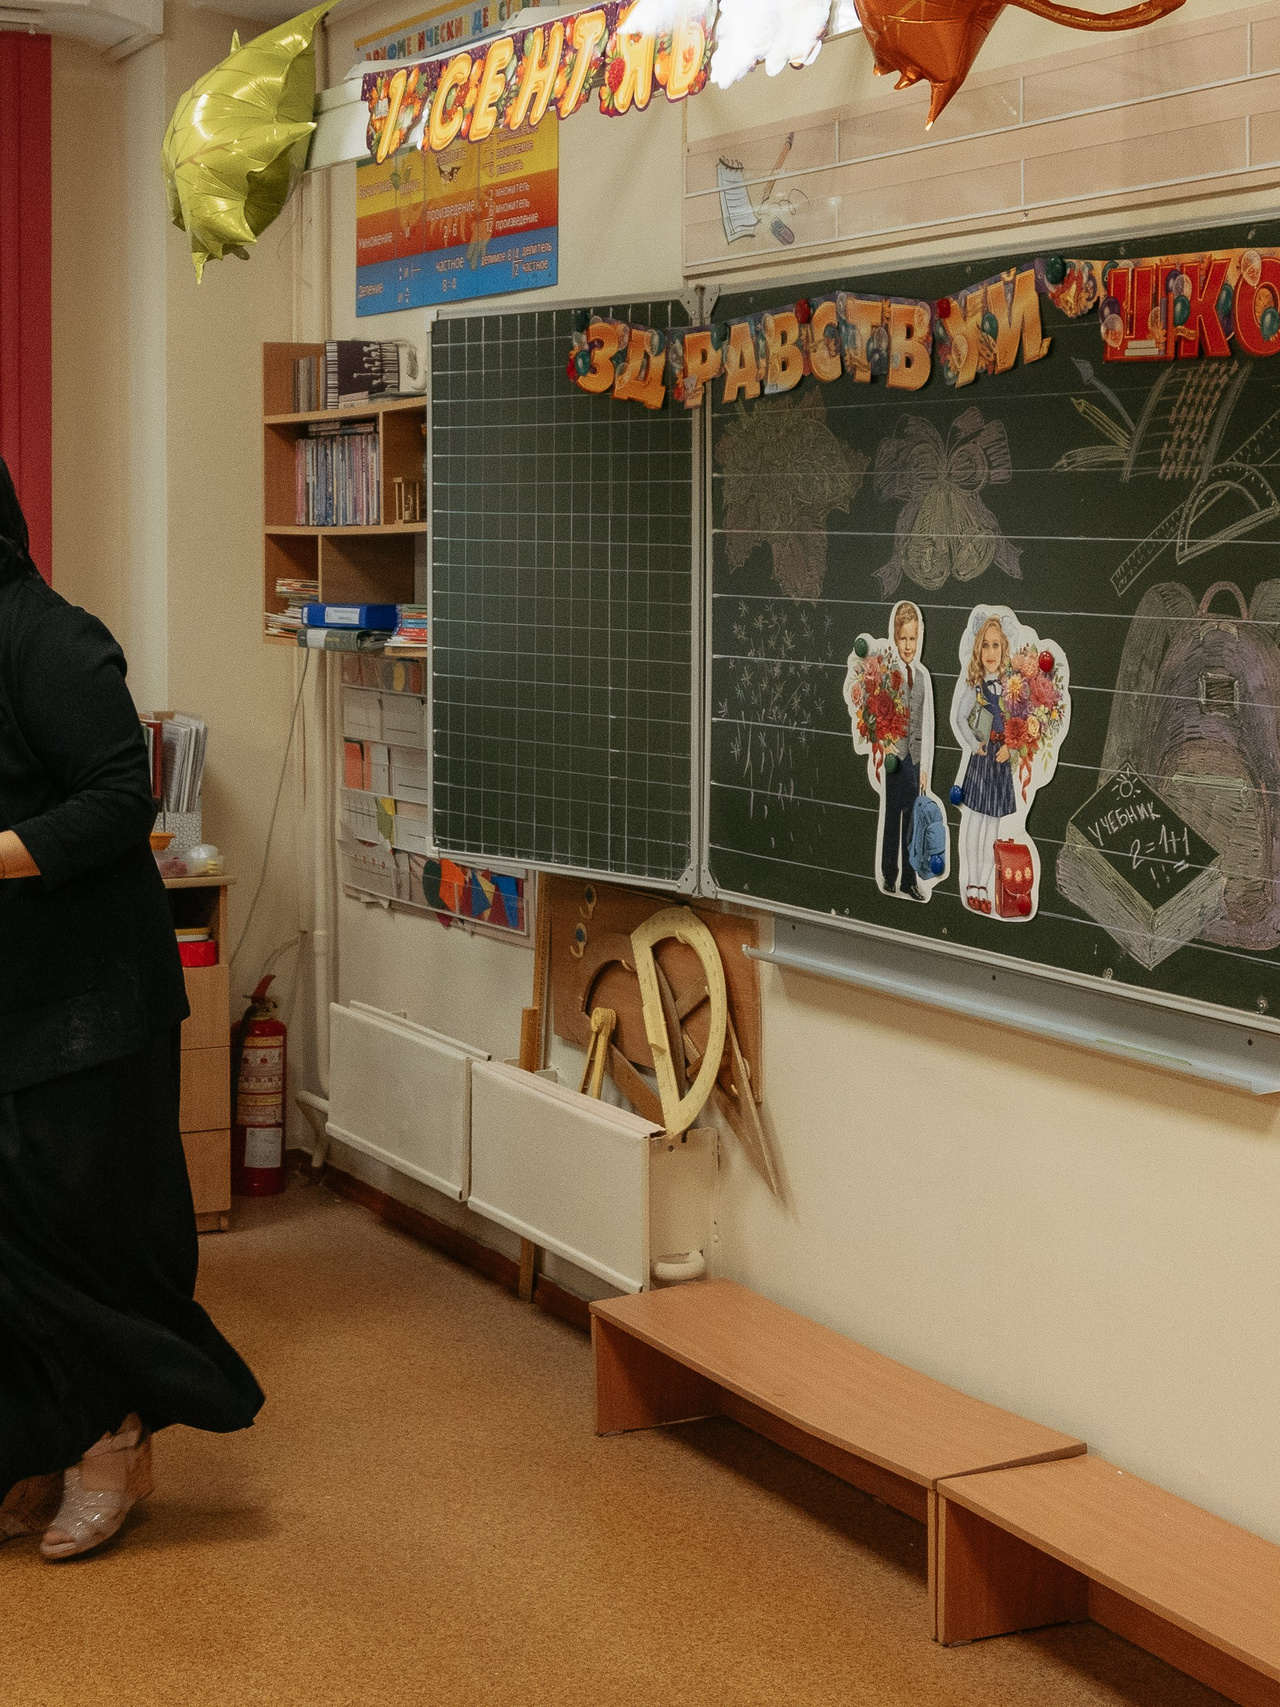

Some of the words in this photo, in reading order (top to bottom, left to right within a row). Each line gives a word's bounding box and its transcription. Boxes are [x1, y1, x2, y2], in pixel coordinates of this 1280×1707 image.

[376, 69, 407, 163] 1
[430, 3, 704, 151] СЕНТЯБ
[495, 182, 530, 197] множитель
[426, 200, 475, 222] произведение
[495, 198, 530, 213] множитель
[495, 212, 539, 231] произведение
[521, 242, 552, 258] делитель
[435, 256, 464, 272] частное
[522, 260, 549, 272] частное
[1087, 801, 1161, 846] УЧЕБНИК
